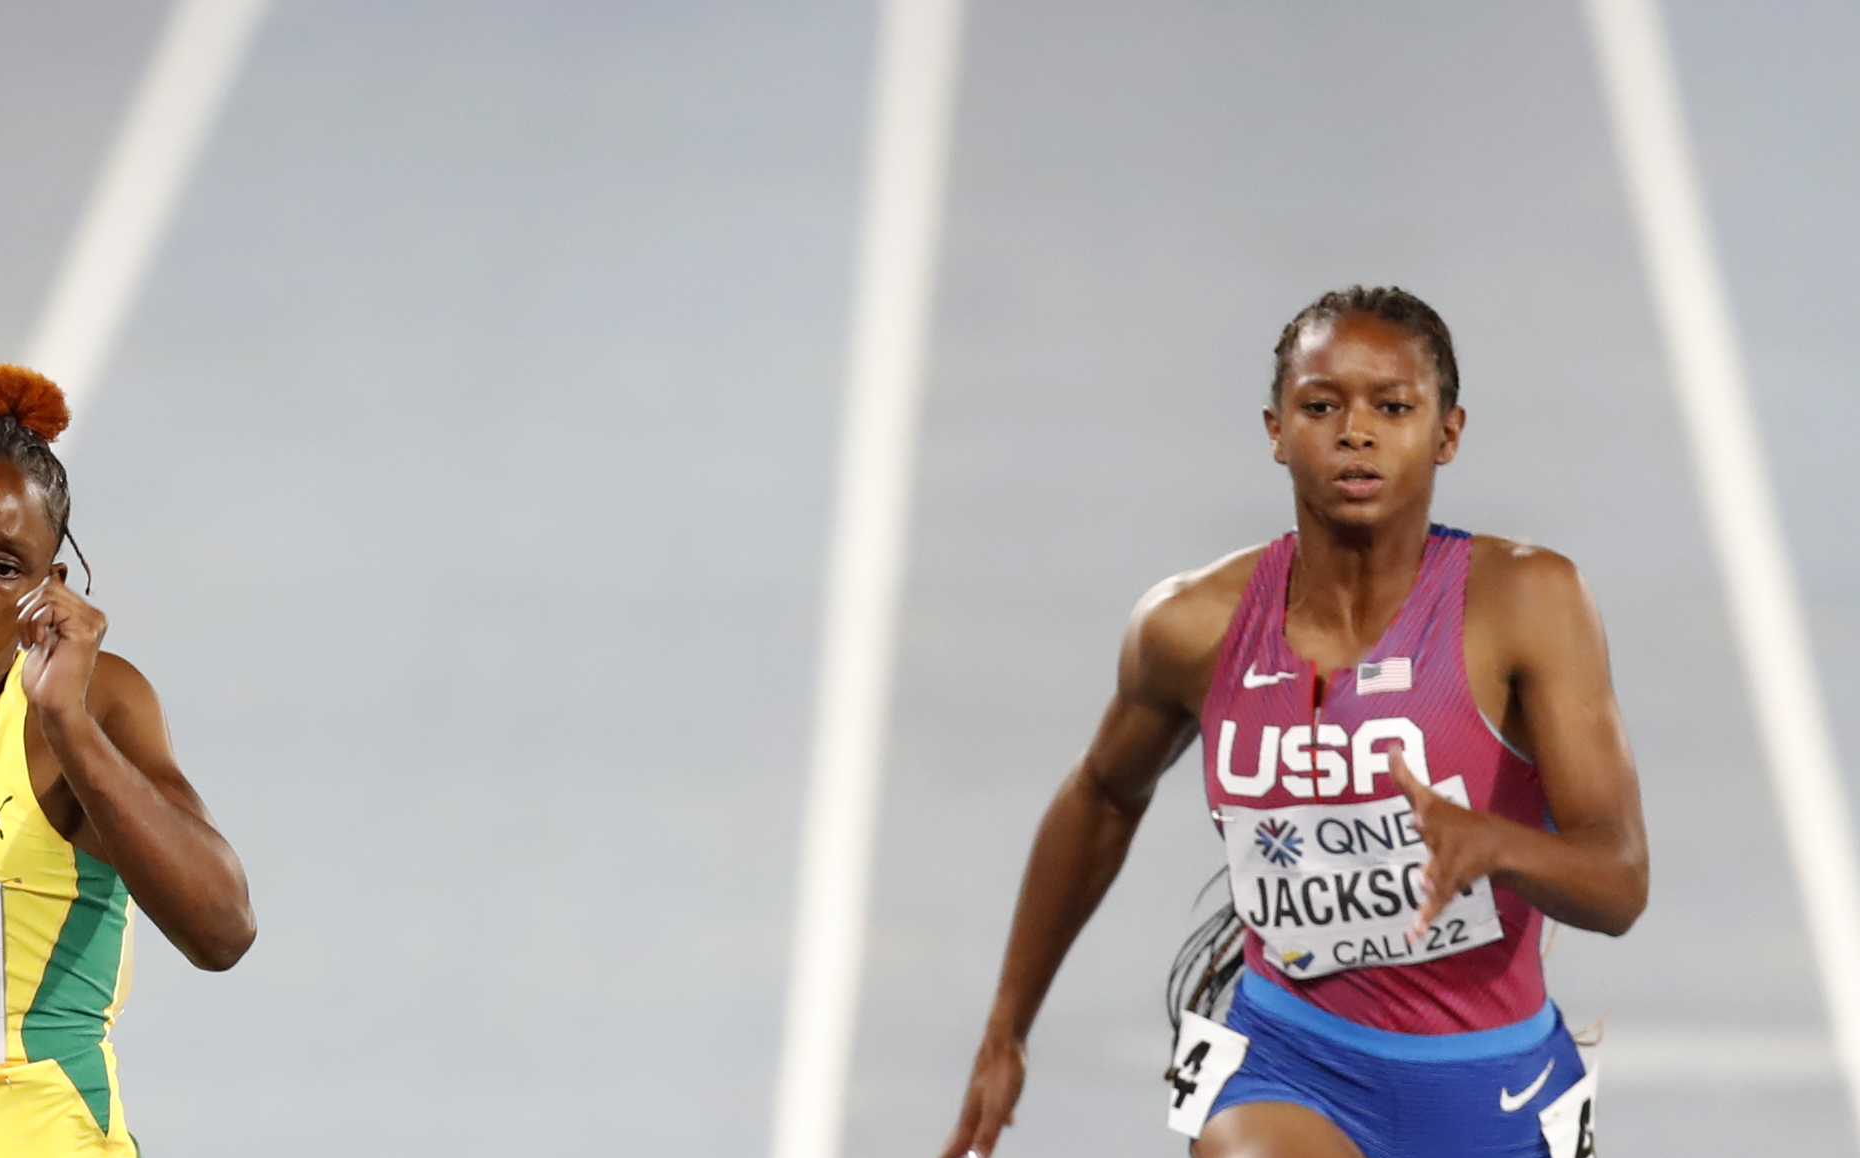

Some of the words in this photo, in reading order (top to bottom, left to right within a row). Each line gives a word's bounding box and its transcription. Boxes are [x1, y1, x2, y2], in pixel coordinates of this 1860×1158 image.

[1216, 716, 1431, 798] USA
[1331, 934, 1414, 965] CALI
[1425, 917, 1470, 952] 22
[1173, 1040, 1212, 1110] 4
